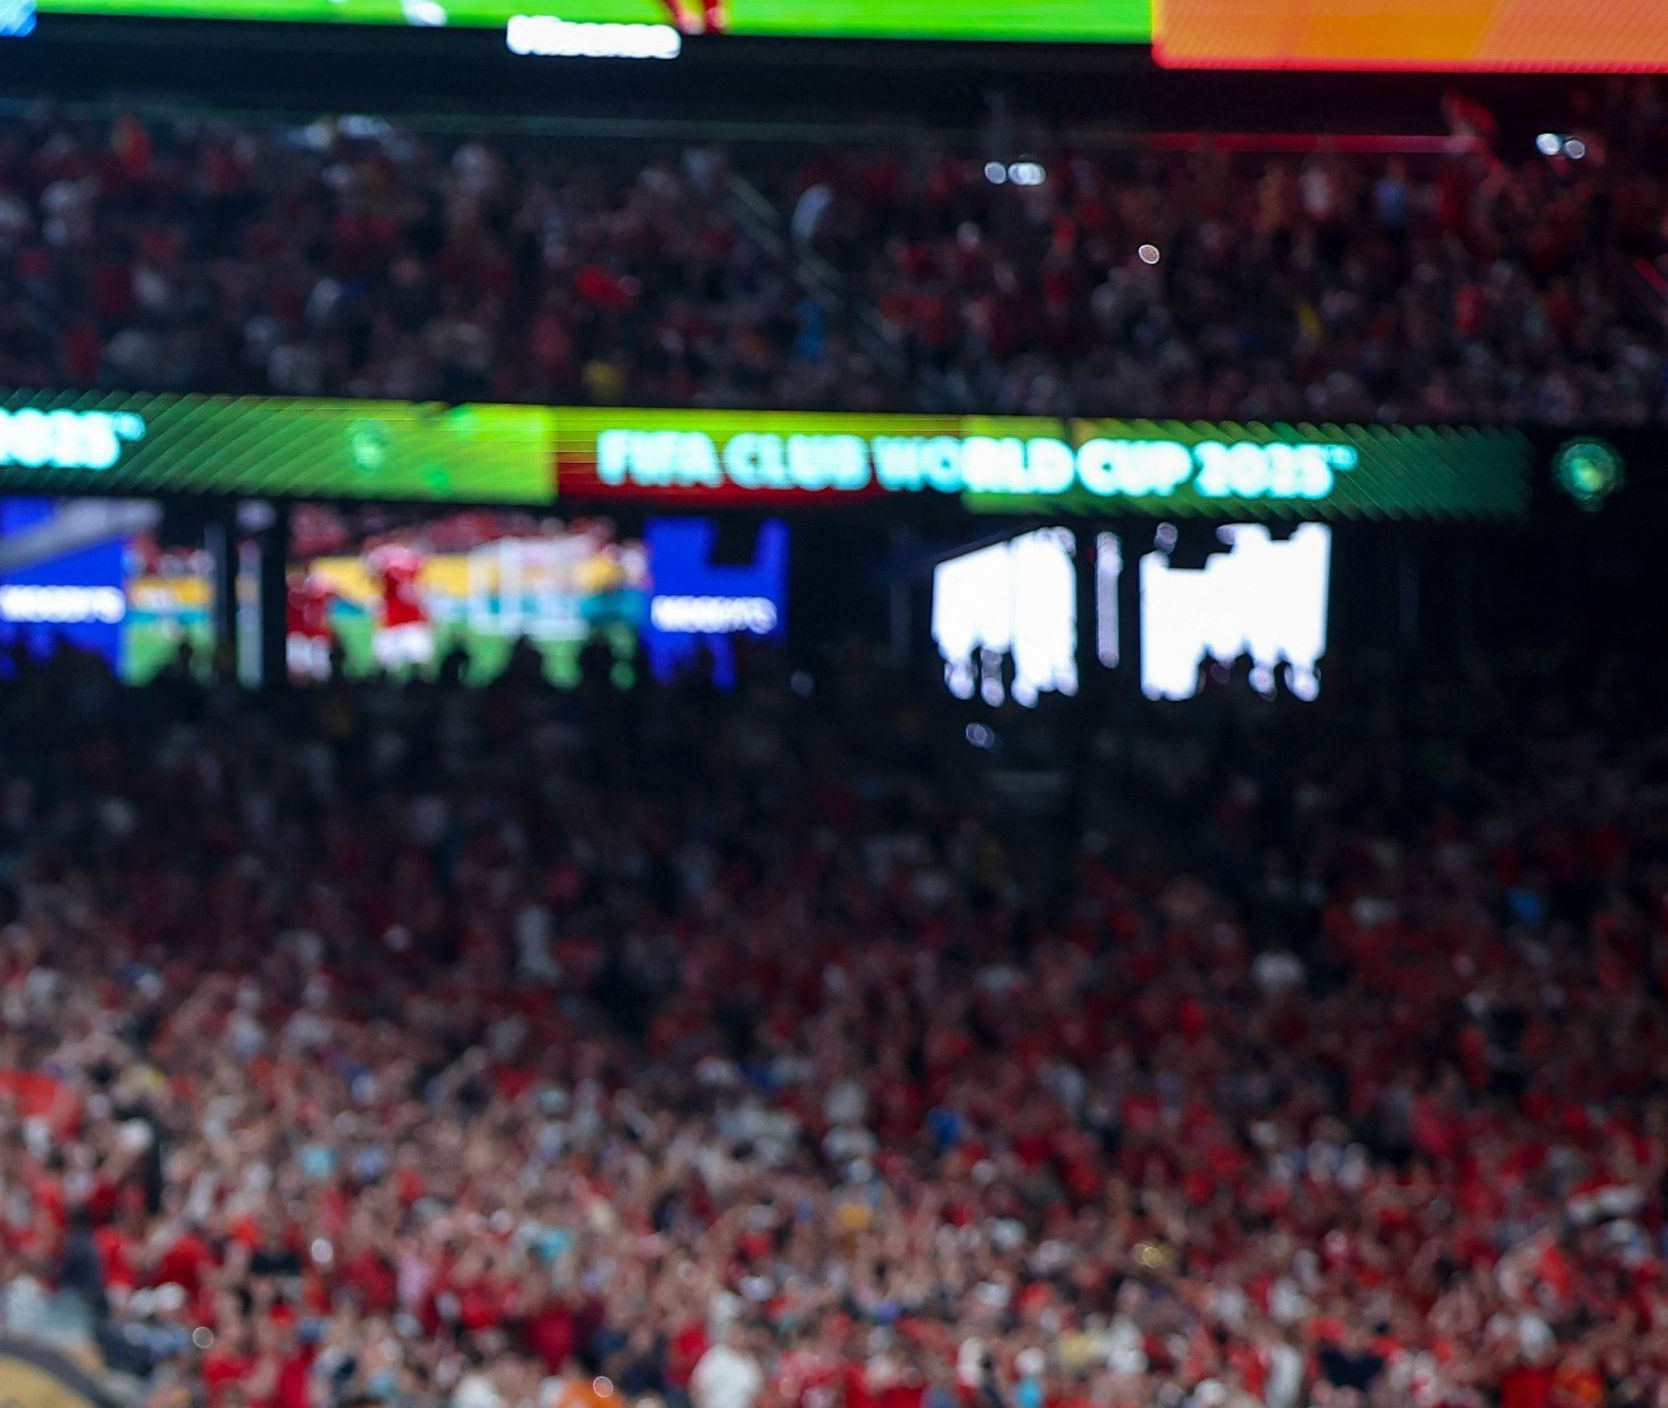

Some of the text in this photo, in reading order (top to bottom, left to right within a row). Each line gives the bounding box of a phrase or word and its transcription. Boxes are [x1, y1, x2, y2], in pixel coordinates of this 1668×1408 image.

[596, 429, 722, 489] FIFA
[723, 433, 866, 491] CLUB
[871, 437, 1075, 494] WORLD
[1075, 438, 1194, 495] CUP
